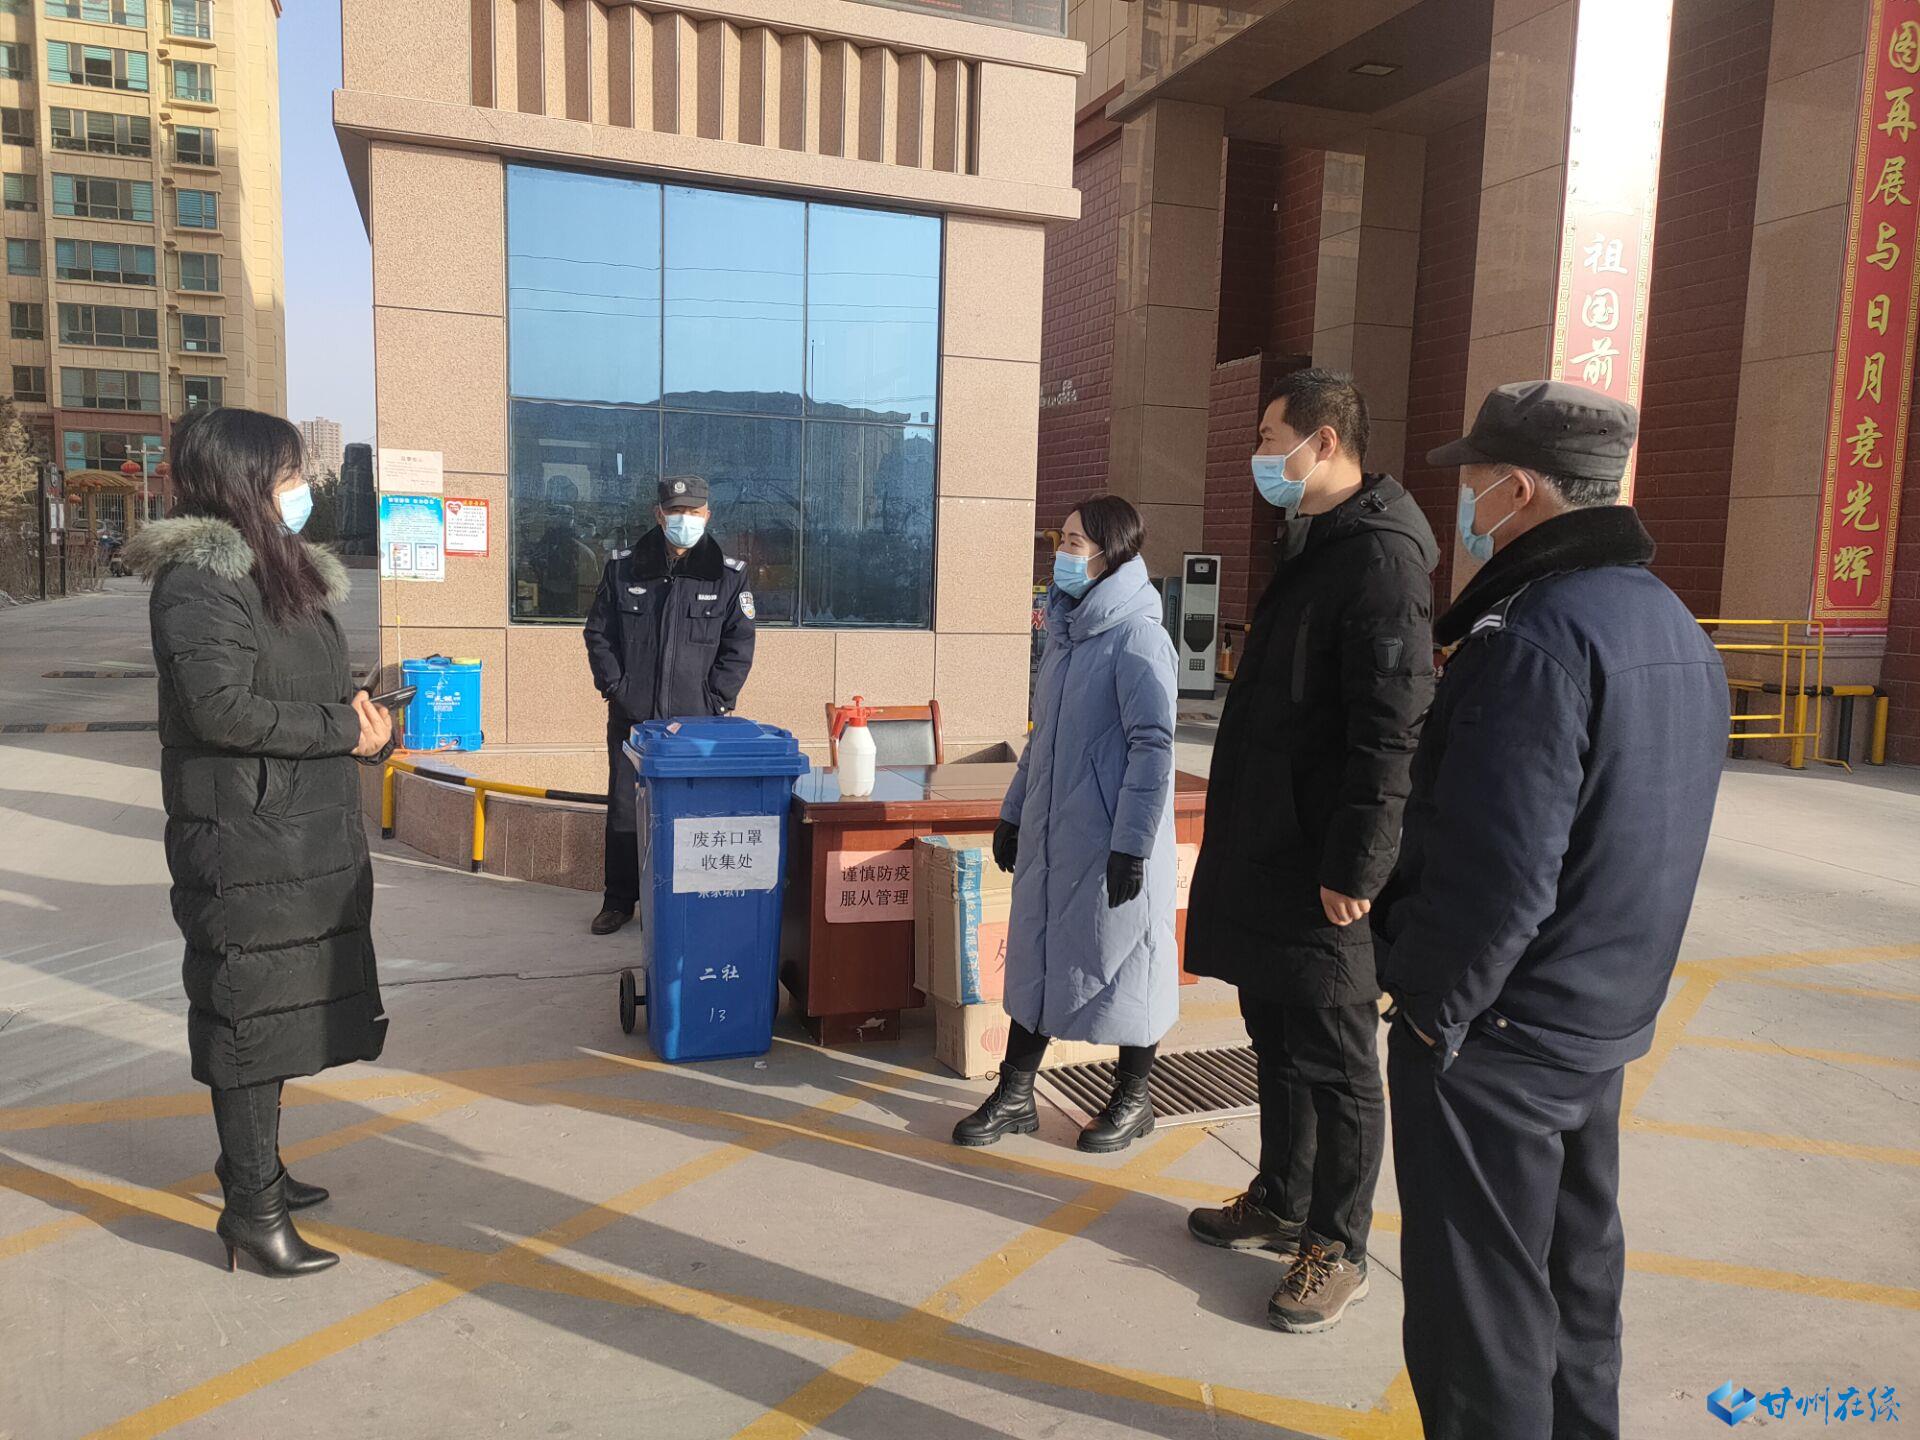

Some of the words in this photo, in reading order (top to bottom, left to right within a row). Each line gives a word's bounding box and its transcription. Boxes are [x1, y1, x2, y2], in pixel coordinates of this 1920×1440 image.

[692, 829, 763, 848] 废弃口罩
[701, 853, 753, 871] 收集处
[842, 865, 910, 882] 谨慎防疫
[840, 889, 909, 907] 服从管理
[699, 964, 740, 982] 二社
